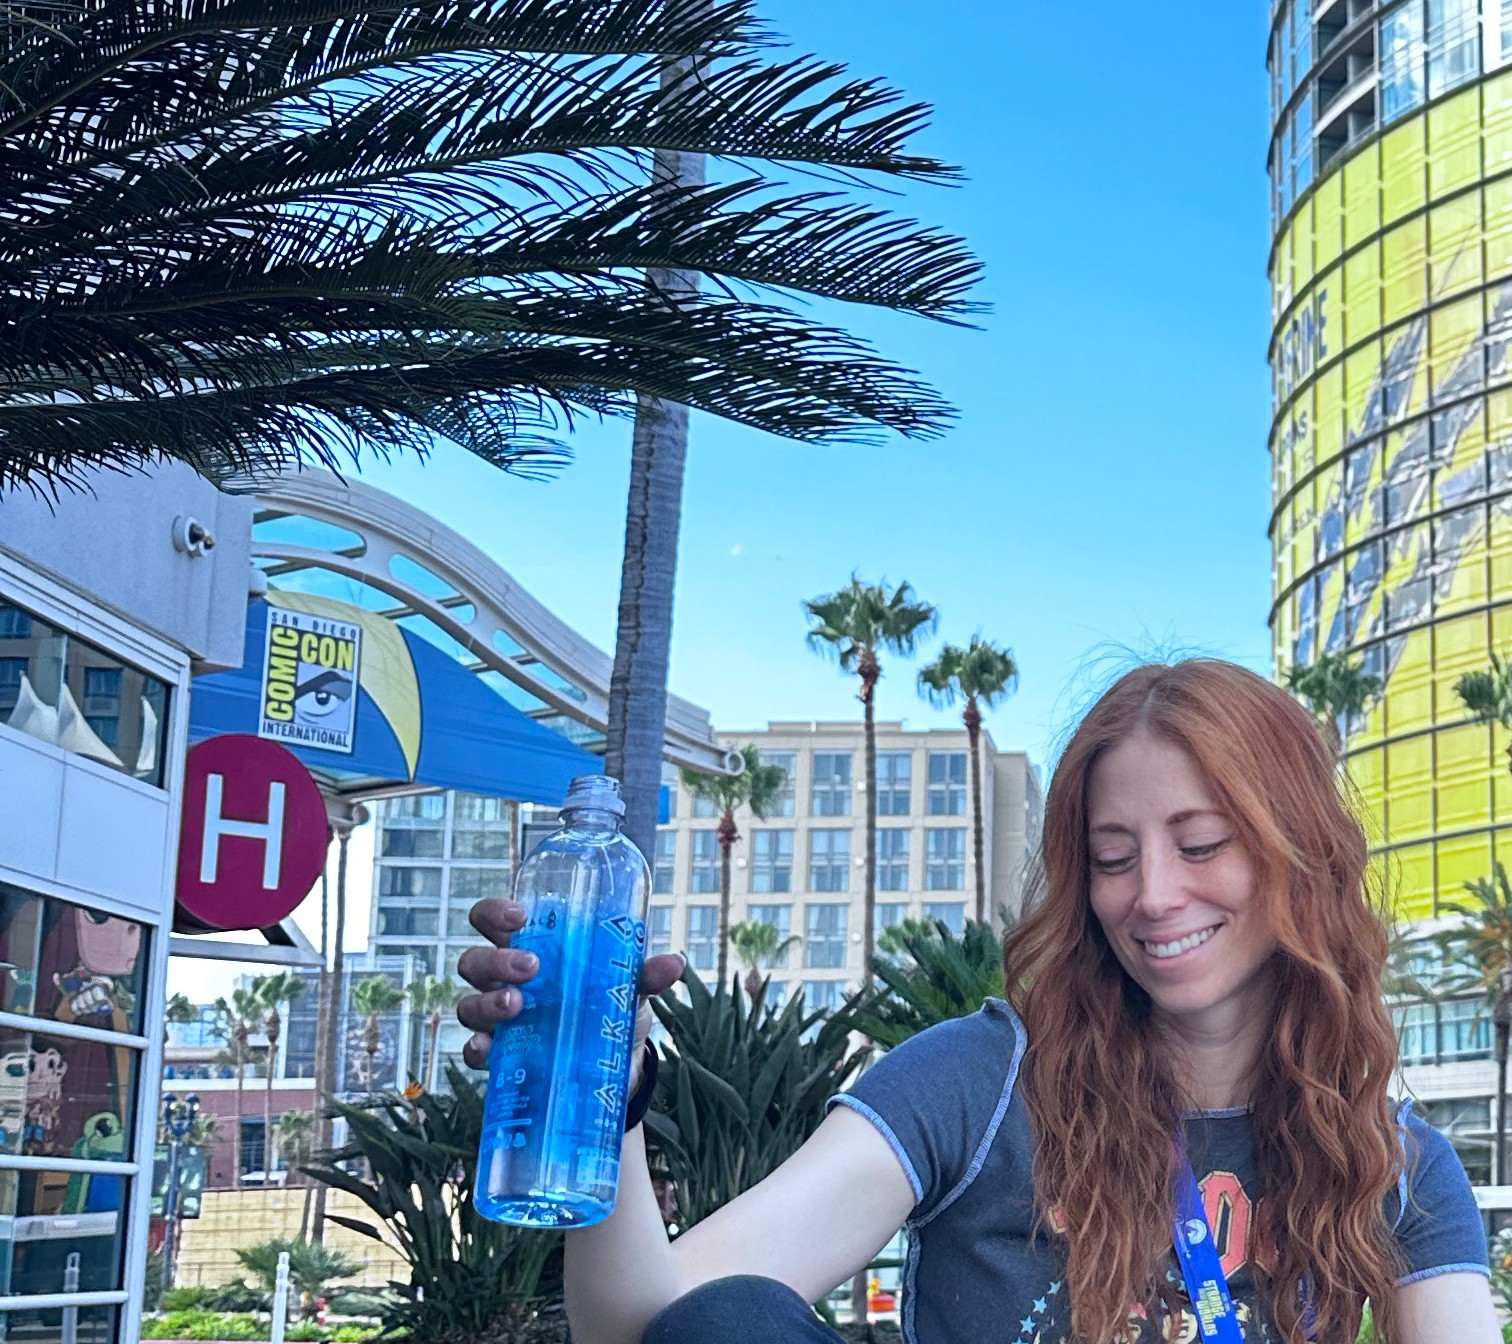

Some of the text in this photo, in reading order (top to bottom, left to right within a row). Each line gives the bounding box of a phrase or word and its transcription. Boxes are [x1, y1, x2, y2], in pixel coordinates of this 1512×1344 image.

[272, 612, 357, 639] SAN DIEGO
[301, 633, 354, 671] CON
[266, 627, 299, 721] COMIC
[262, 721, 349, 747] INTERNATIONAL
[199, 773, 286, 890] H
